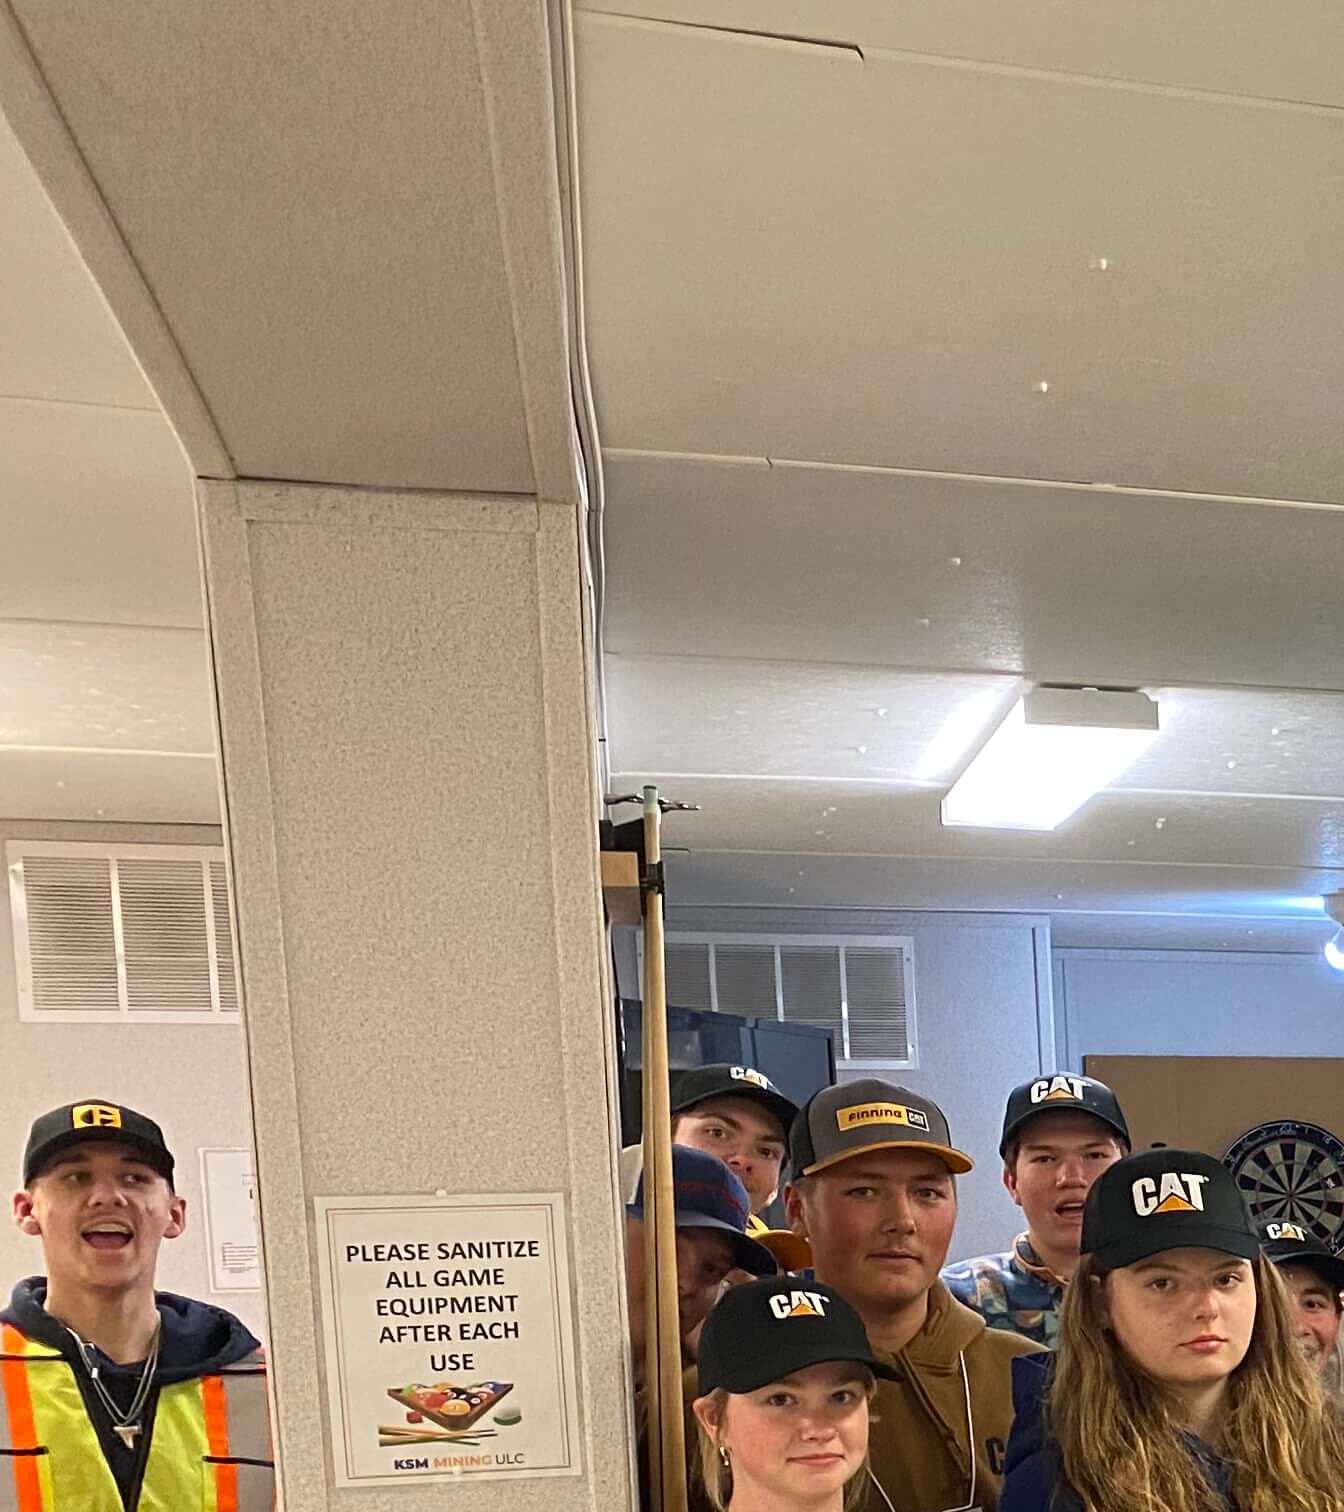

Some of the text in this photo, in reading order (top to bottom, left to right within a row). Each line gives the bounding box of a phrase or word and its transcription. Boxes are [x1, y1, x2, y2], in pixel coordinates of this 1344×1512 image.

[730, 1066, 770, 1090] CAT
[1030, 1076, 1091, 1104] CAT
[1132, 1173, 1209, 1217] CAT
[1265, 1222, 1307, 1241] CAT
[346, 1240, 540, 1262] PLEASE SANITIZE
[386, 1268, 505, 1288] ALL GAME
[376, 1295, 519, 1318] EQUIPMENT
[769, 1291, 829, 1319] CAT
[379, 1321, 519, 1344] AFTER EACH
[430, 1353, 475, 1372] USE
[394, 1452, 525, 1470] KSM MINING ULC
